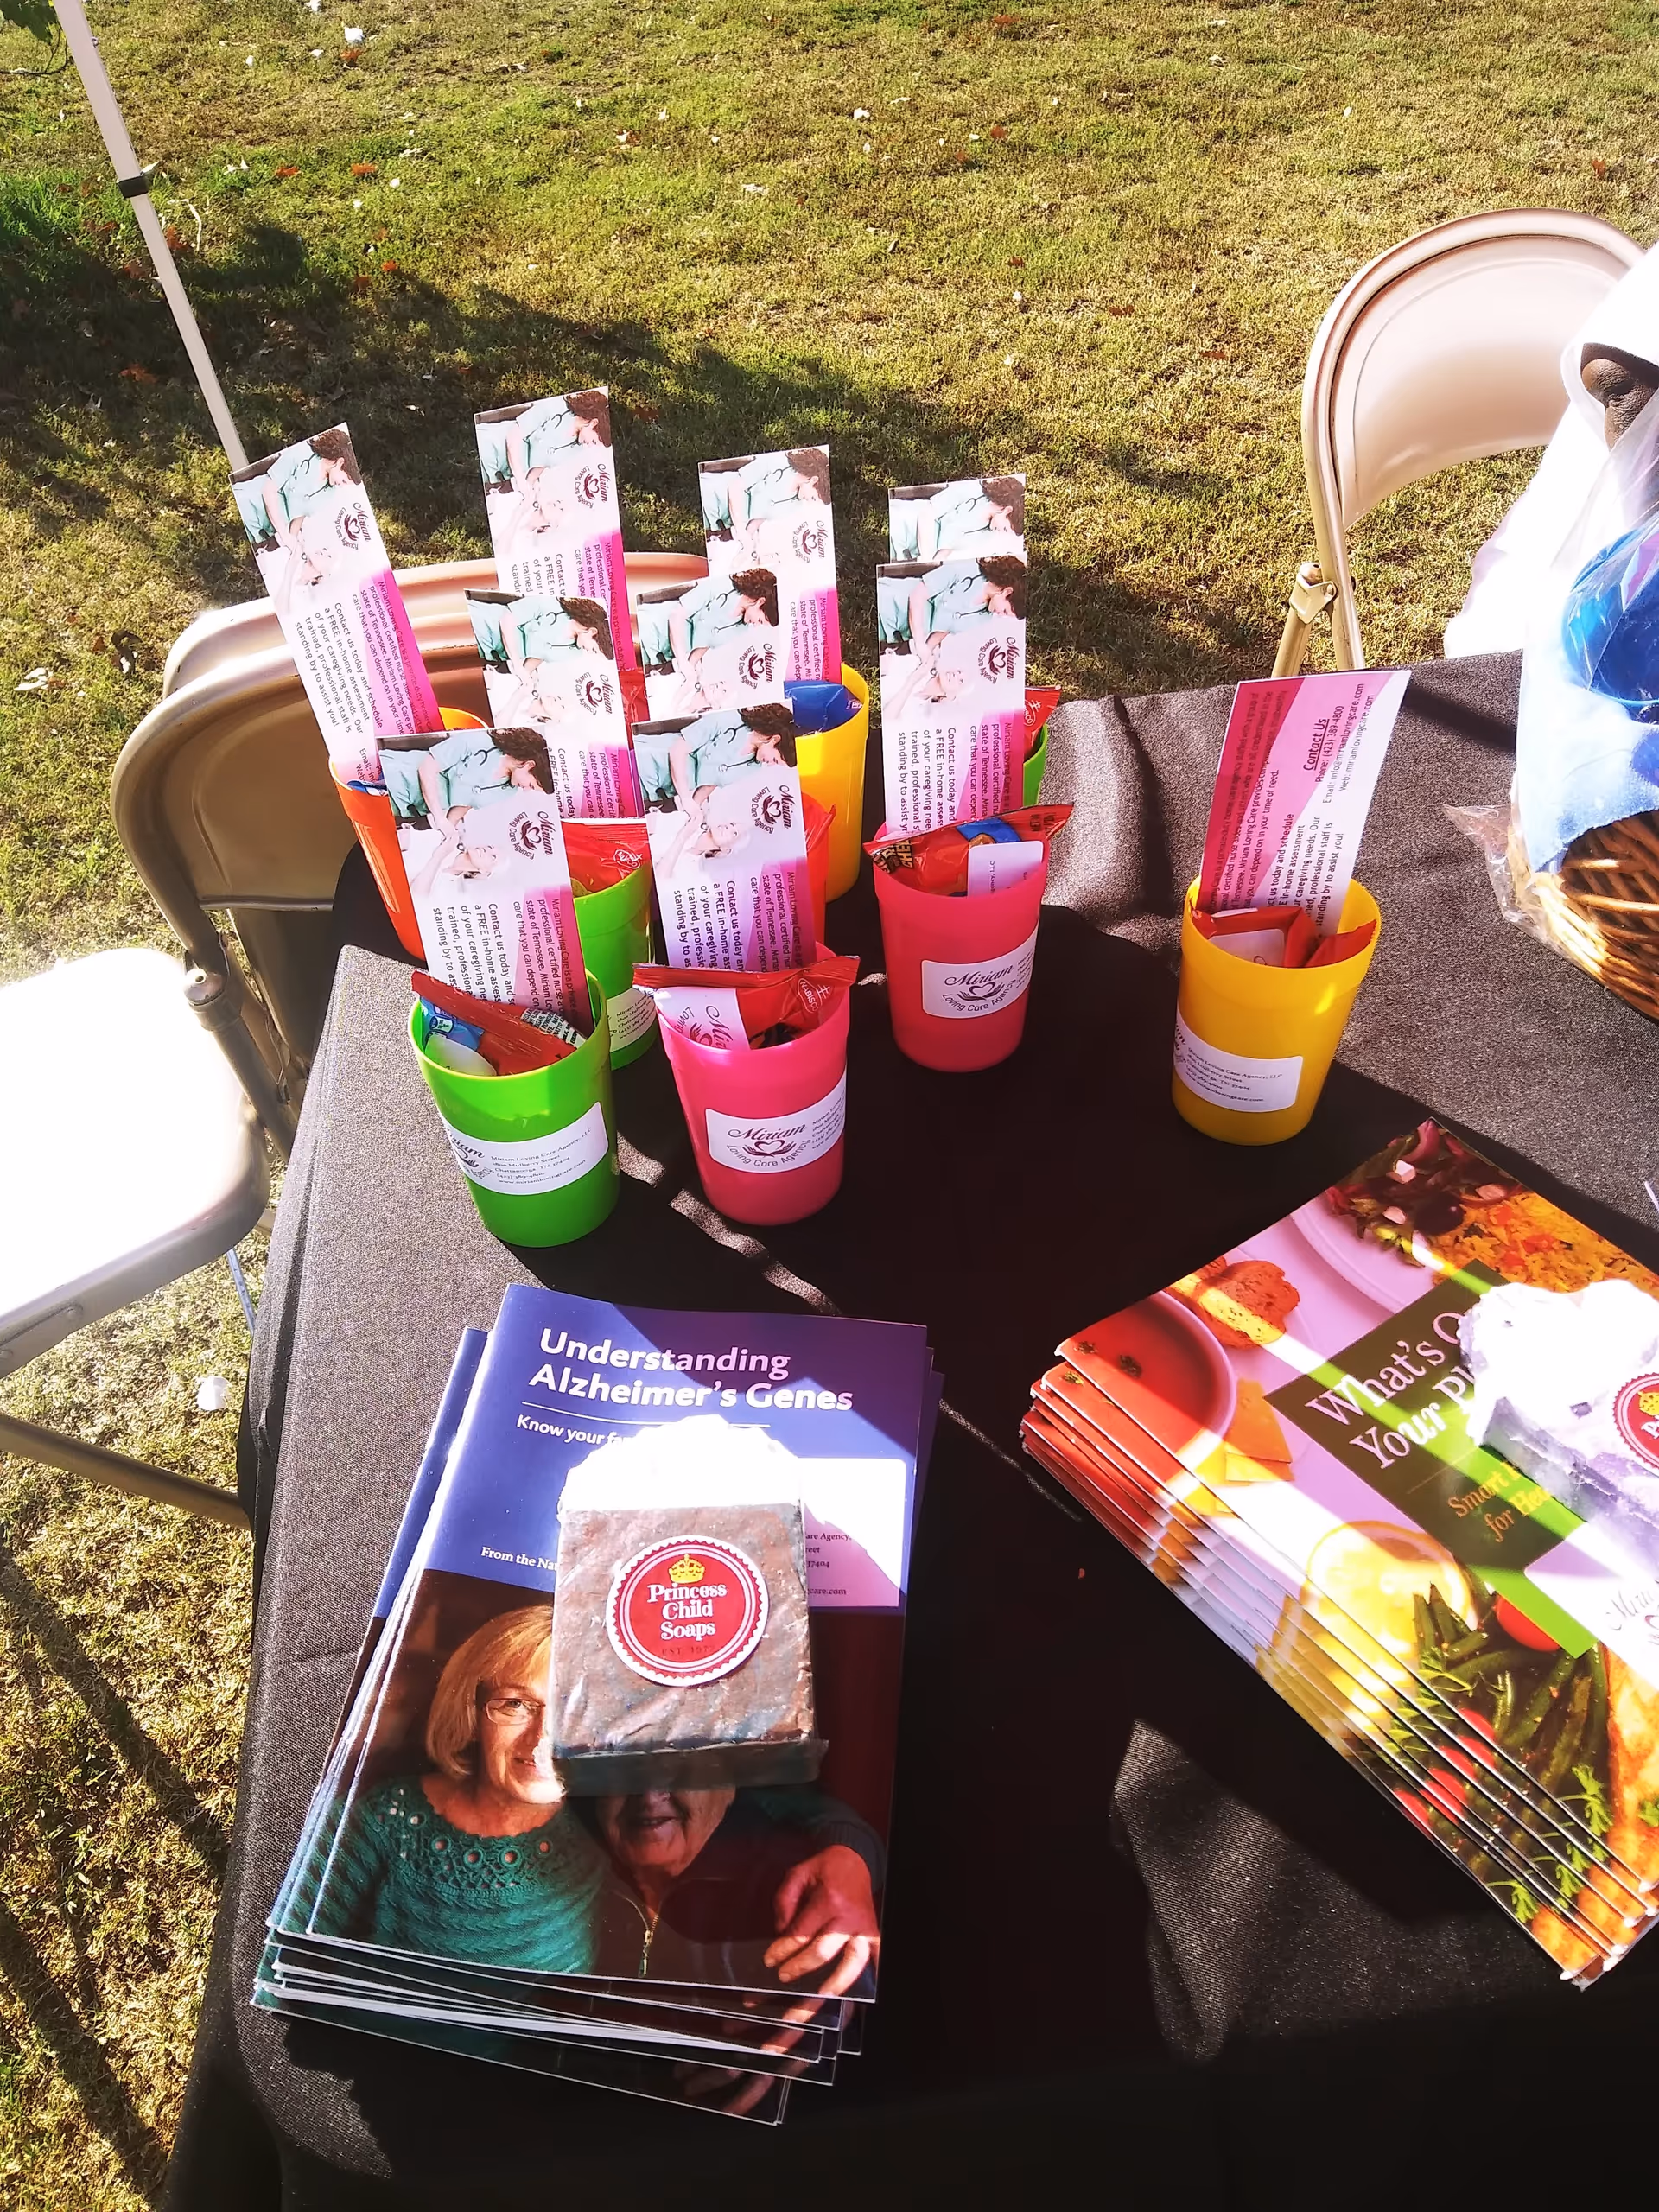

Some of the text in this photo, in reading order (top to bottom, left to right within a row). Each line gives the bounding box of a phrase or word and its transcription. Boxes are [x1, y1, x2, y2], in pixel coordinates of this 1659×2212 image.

[597, 463, 610, 501] Miriam
[334, 507, 346, 524] Loving
[340, 537, 358, 550] Agency
[353, 502, 370, 540] Miriam
[816, 520, 828, 557] Miriam
[315, 612, 323, 620] of
[317, 623, 329, 642] your
[979, 637, 996, 652] Loving
[295, 622, 312, 659] standing
[309, 659, 317, 671] by
[315, 672, 321, 682] to
[318, 684, 331, 707] assist
[327, 645, 346, 689] caregiving
[327, 614, 340, 637] FREE
[336, 639, 352, 673] in-home
[349, 676, 369, 721] assessment
[334, 602, 382, 728] Contact us today and schedule
[739, 645, 754, 660] Loving
[763, 643, 776, 681] Miriam
[1007, 637, 1019, 678] Miriam
[318, 653, 341, 704] professional
[338, 705, 349, 723] staff
[575, 671, 591, 683] Loving
[741, 675, 757, 689] Agency
[980, 667, 997, 683] Agency
[579, 699, 596, 715] Agency
[600, 674, 613, 713] Miriam
[354, 719, 363, 733] Our
[1303, 718, 1326, 770] Contact Us
[921, 729, 931, 810] of your caregiving
[948, 766, 954, 775] us
[1314, 759, 1328, 782] Phone:
[751, 786, 769, 802] Loving
[912, 770, 920, 823] professional
[946, 778, 956, 802] today
[509, 811, 527, 827] Loving
[779, 785, 794, 828] Miriam
[948, 805, 957, 821] and
[538, 811, 555, 854] Miriam
[754, 817, 773, 834] Agency
[1279, 814, 1294, 847] schedule
[512, 842, 534, 859] Agency
[1274, 849, 1285, 863] and
[1280, 825, 1304, 899] in-home assessment
[1295, 860, 1312, 897] caregiving
[1309, 817, 1319, 830] Our
[1309, 849, 1325, 894] professional
[1320, 831, 1330, 847] staff
[1327, 852, 1338, 872] assist
[1270, 865, 1283, 886] today
[1320, 884, 1332, 893] by
[1324, 874, 1333, 882] to
[488, 903, 516, 995] Contact us today and
[944, 965, 1013, 986] Miriam
[799, 980, 819, 1013] NABISCO
[942, 979, 1016, 1012] Loving Care Agency
[673, 1006, 696, 1034] Loving
[728, 1124, 805, 1141] Miriam
[727, 1145, 752, 1165] Loving
[781, 1139, 811, 1164] Agency
[539, 1327, 791, 1380] Understanding
[529, 1363, 854, 1411] Alzheimer's Genes
[1305, 1340, 1446, 1426] What's
[517, 1414, 564, 1436] Know
[567, 1427, 605, 1446] your
[1350, 1402, 1446, 1469] Your
[1448, 1471, 1509, 1518] Smart
[1484, 1509, 1515, 1542] for
[480, 1546, 514, 1562] From
[516, 1554, 536, 1566] the
[647, 1583, 728, 1603] Princess
[662, 1599, 713, 1620] Child
[660, 1621, 716, 1641] Soaps
